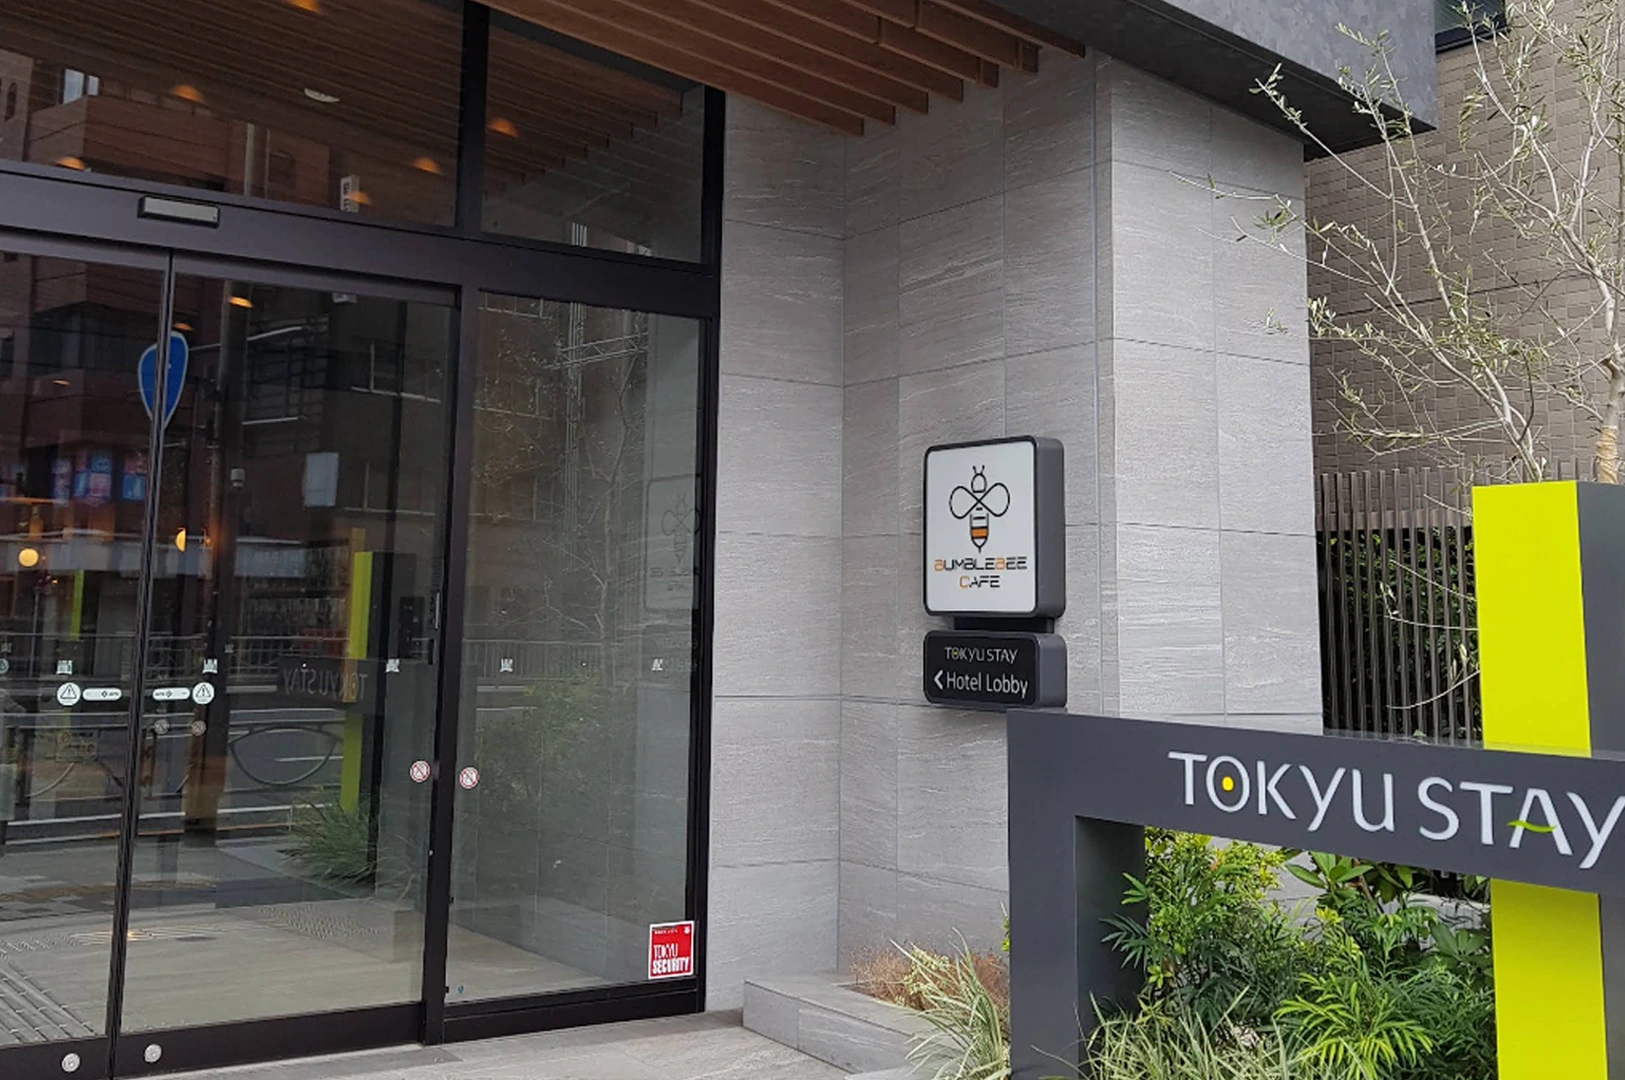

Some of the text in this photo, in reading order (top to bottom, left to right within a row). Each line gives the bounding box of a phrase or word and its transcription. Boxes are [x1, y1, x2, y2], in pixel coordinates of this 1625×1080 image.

[934, 556, 1027, 572] BUMBLEBEE
[959, 575, 1000, 589] CAFE
[944, 646, 1018, 664] TOKYU STAY
[946, 670, 1028, 699] Hotel Lobby
[1168, 751, 1625, 869] TOKYU STAY
[653, 943, 678, 960] TOKYU
[653, 956, 689, 974] SECURITY
